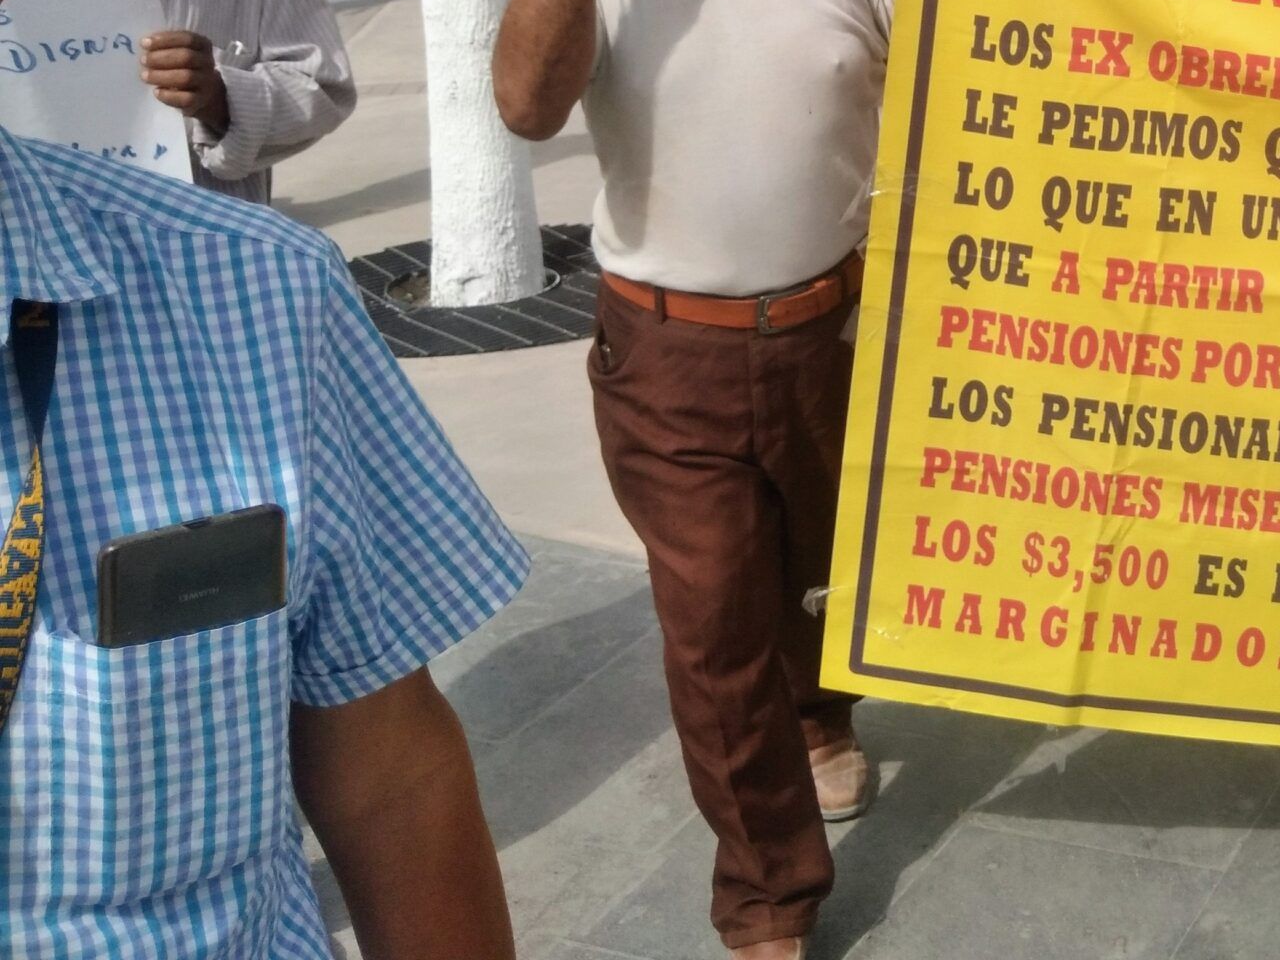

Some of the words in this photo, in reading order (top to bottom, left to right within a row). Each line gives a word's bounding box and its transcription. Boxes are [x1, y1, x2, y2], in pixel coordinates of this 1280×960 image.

[971, 15, 1054, 70] LOS
[1068, 27, 1133, 77] EX
[962, 88, 1017, 139] LE
[1038, 101, 1243, 162] PEDIMOS
[954, 161, 1014, 210] LO
[1042, 176, 1132, 233] QUE
[1156, 188, 1217, 235] EN
[947, 234, 1033, 290] QUE
[1052, 251, 1080, 294] A
[1102, 258, 1264, 313] PARTIR
[937, 306, 1183, 379] PENSIONES
[928, 377, 1013, 427] LOS
[920, 447, 1163, 519] PENSIONES
[912, 516, 997, 566] LOS
[1022, 532, 1168, 592] $3,500
[1194, 555, 1247, 598] ES
